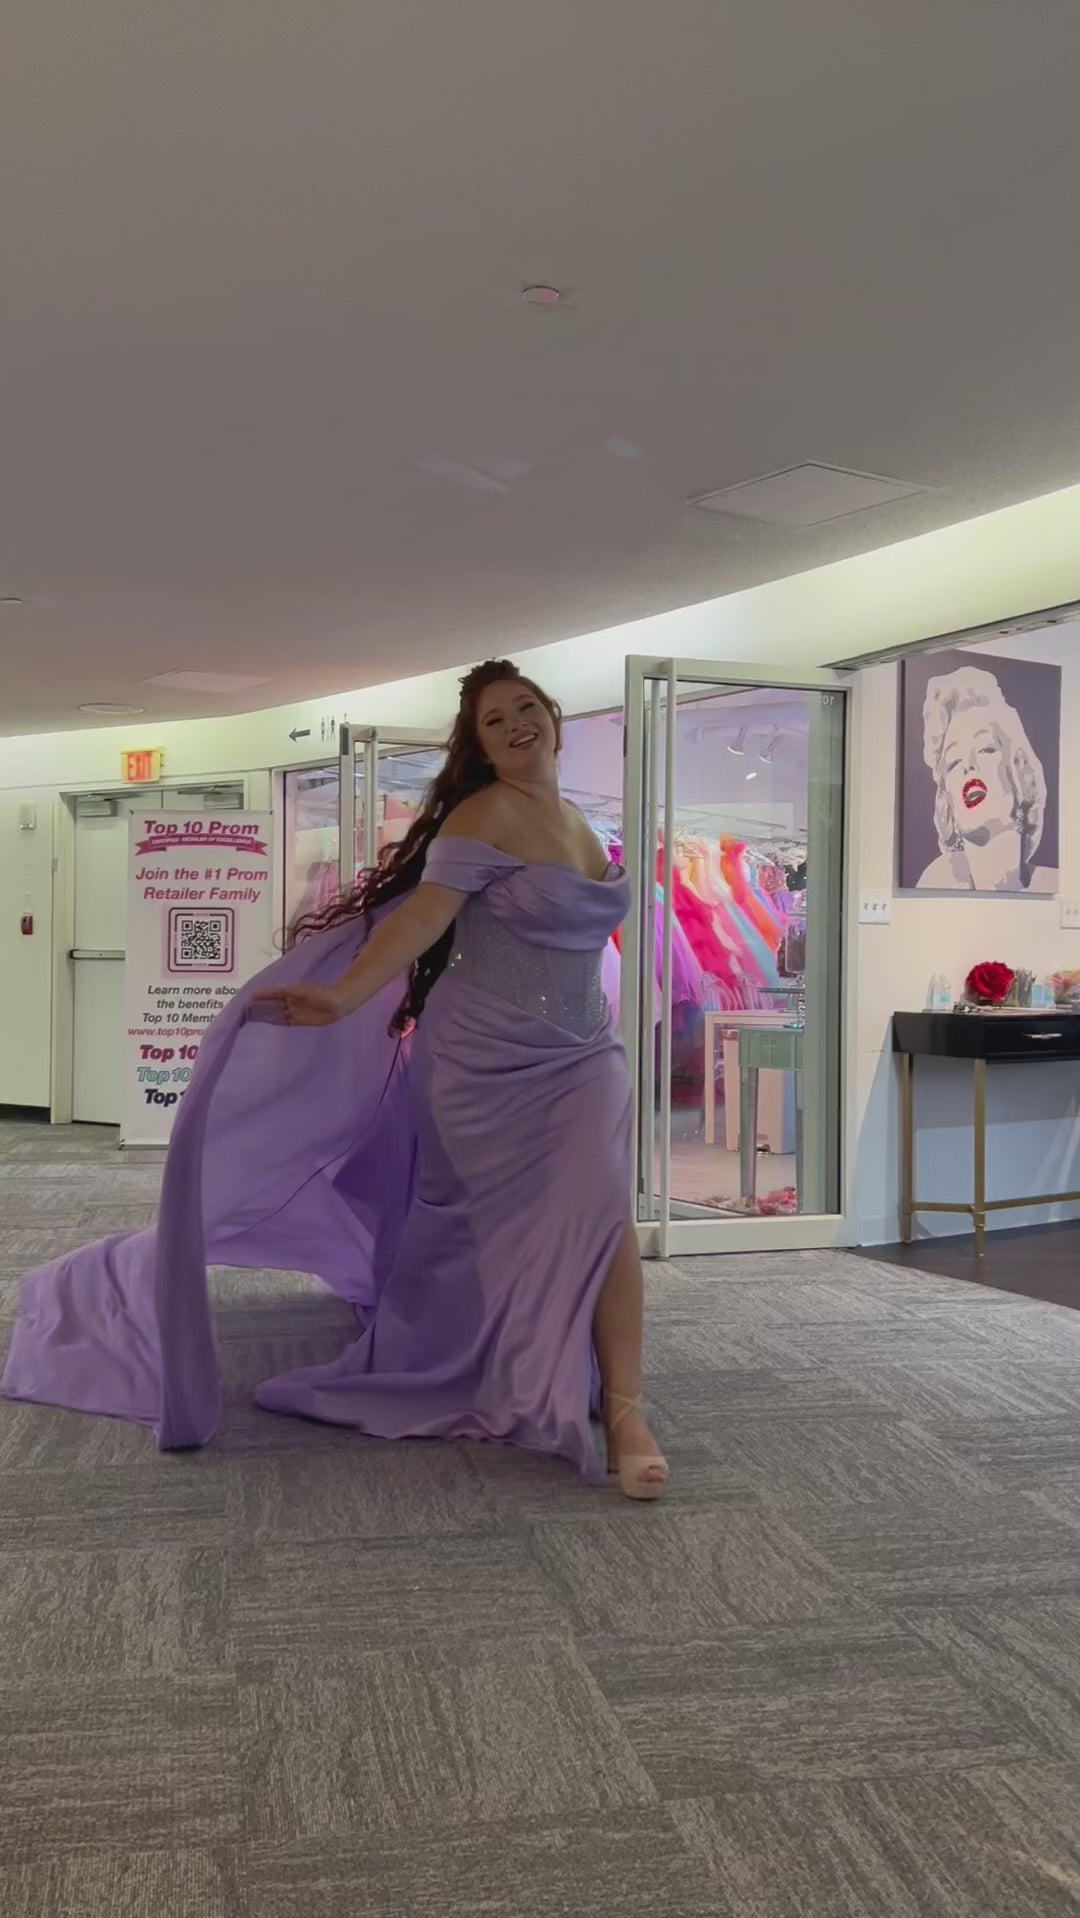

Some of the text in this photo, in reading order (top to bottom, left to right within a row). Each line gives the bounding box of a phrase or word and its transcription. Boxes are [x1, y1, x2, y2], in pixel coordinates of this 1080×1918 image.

[144, 820, 259, 836] Top 10 Prom
[135, 867, 268, 880] Join the #1 Prom
[143, 887, 261, 903] Retailer Family
[147, 985, 180, 995] Learn
[182, 987, 212, 995] more
[156, 999, 224, 1009] the benefits
[142, 1013, 162, 1024] Top
[166, 1013, 179, 1023] 10
[140, 1044, 199, 1062] Top 10
[136, 1066, 193, 1085] Top 10
[144, 1088, 178, 1107] Top
